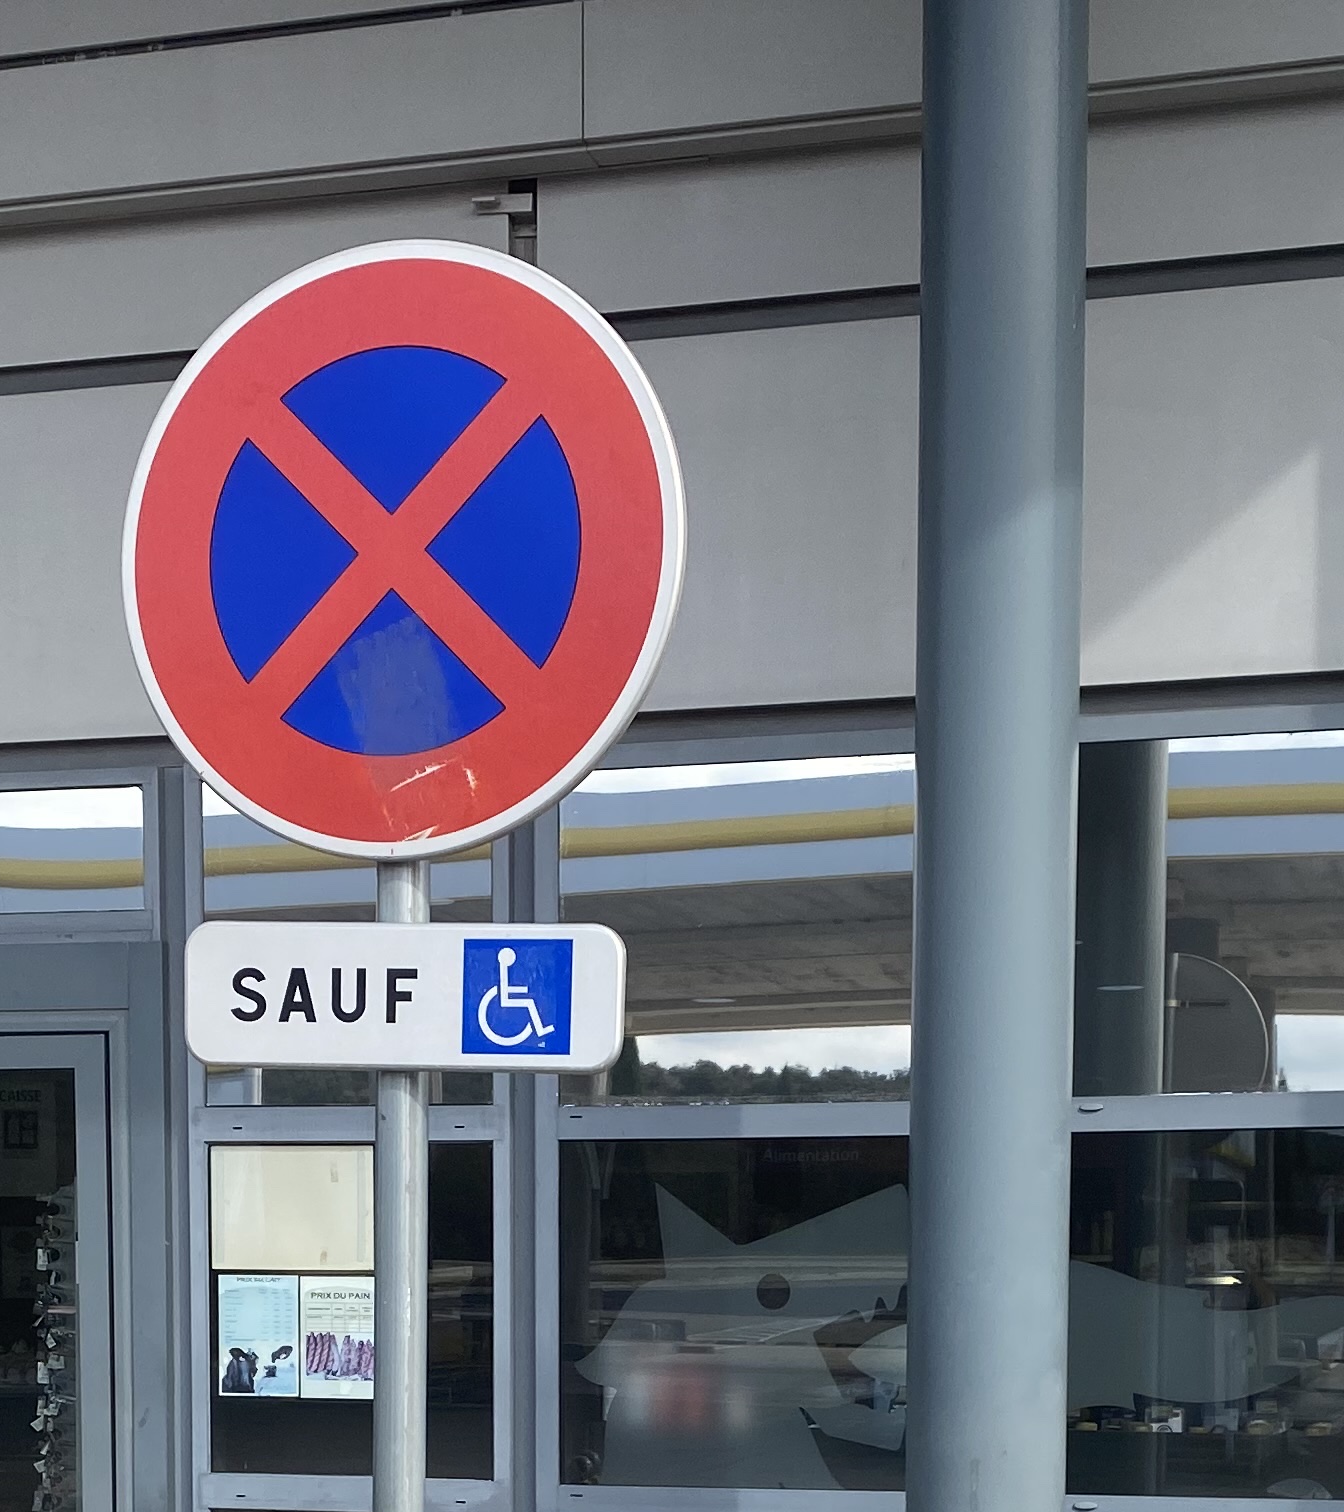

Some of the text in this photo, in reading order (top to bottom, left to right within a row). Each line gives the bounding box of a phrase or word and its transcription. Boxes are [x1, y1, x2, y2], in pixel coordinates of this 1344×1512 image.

[231, 966, 419, 1025] SAUF
[763, 1147, 860, 1163] Alimentation
[310, 1292, 371, 1300] PRIX DU PAIN
